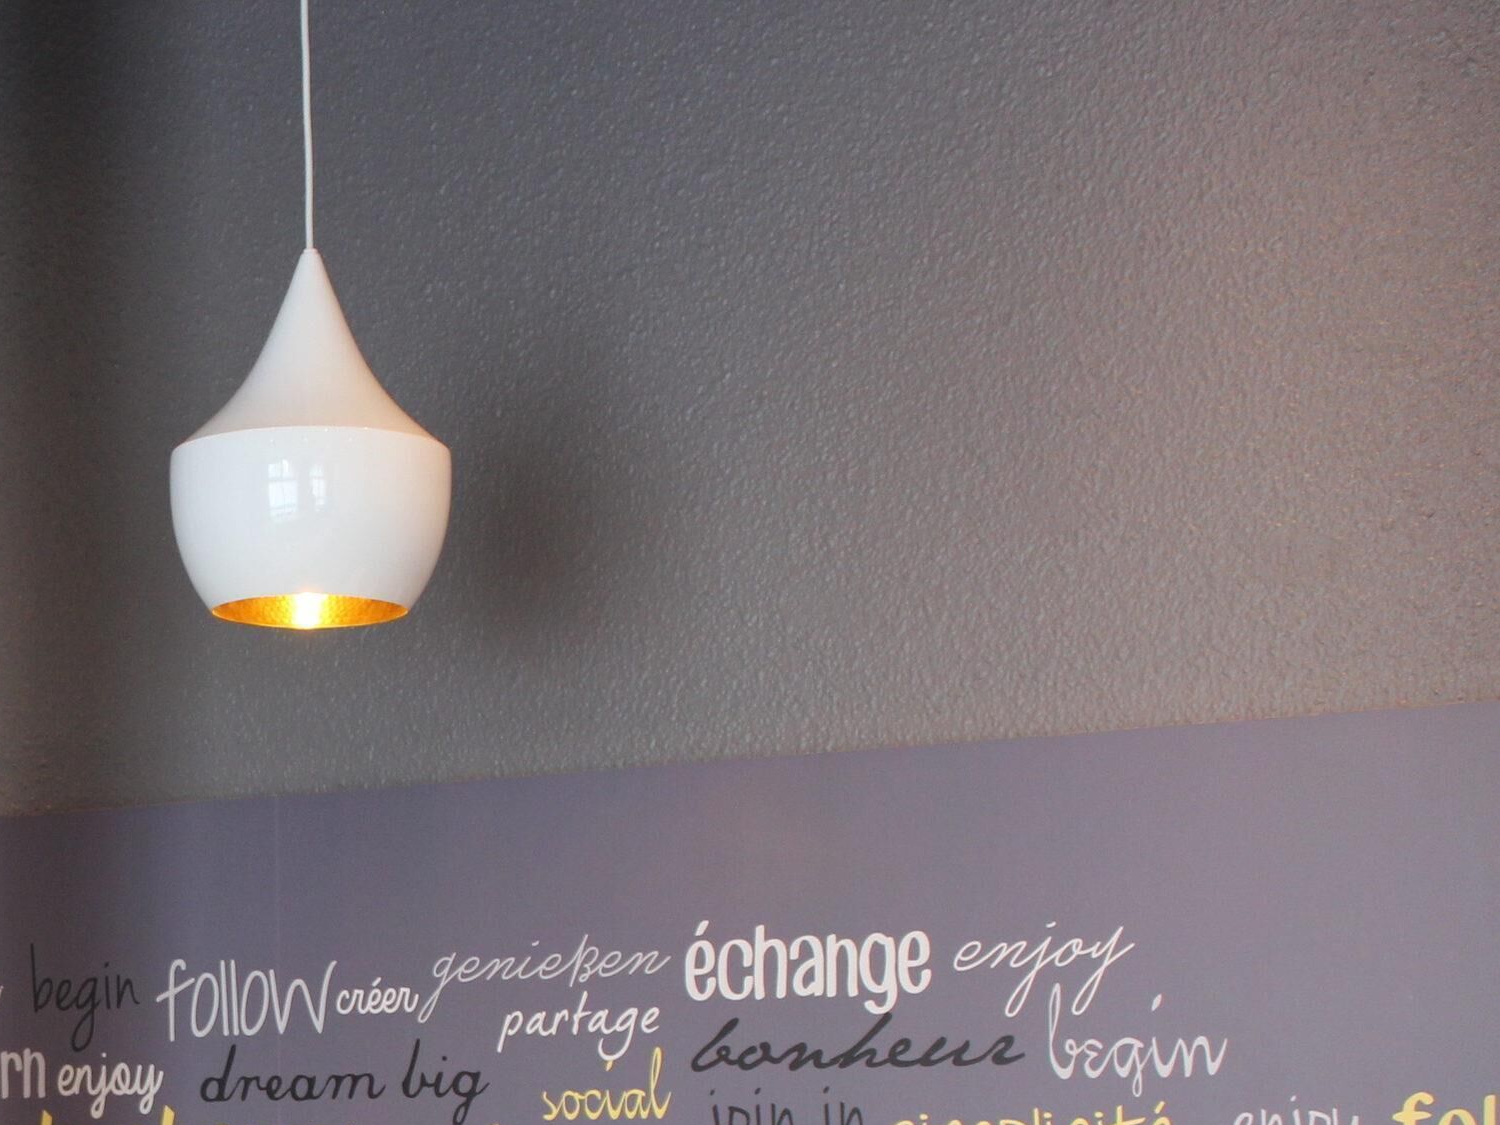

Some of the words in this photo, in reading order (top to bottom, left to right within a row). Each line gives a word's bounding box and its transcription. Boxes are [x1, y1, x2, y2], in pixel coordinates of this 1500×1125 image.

[30, 942, 141, 1052] begin
[155, 958, 338, 1042] follow
[336, 977, 419, 1015] créer
[685, 920, 932, 1015] échange
[953, 921, 1136, 1018] enjoy
[497, 990, 661, 1062] partage
[689, 1012, 1026, 1073] bonheur
[1049, 982, 1228, 1098] begin
[57, 1052, 164, 1119] enjoy
[200, 1043, 386, 1102] dream
[542, 1046, 673, 1121] social
